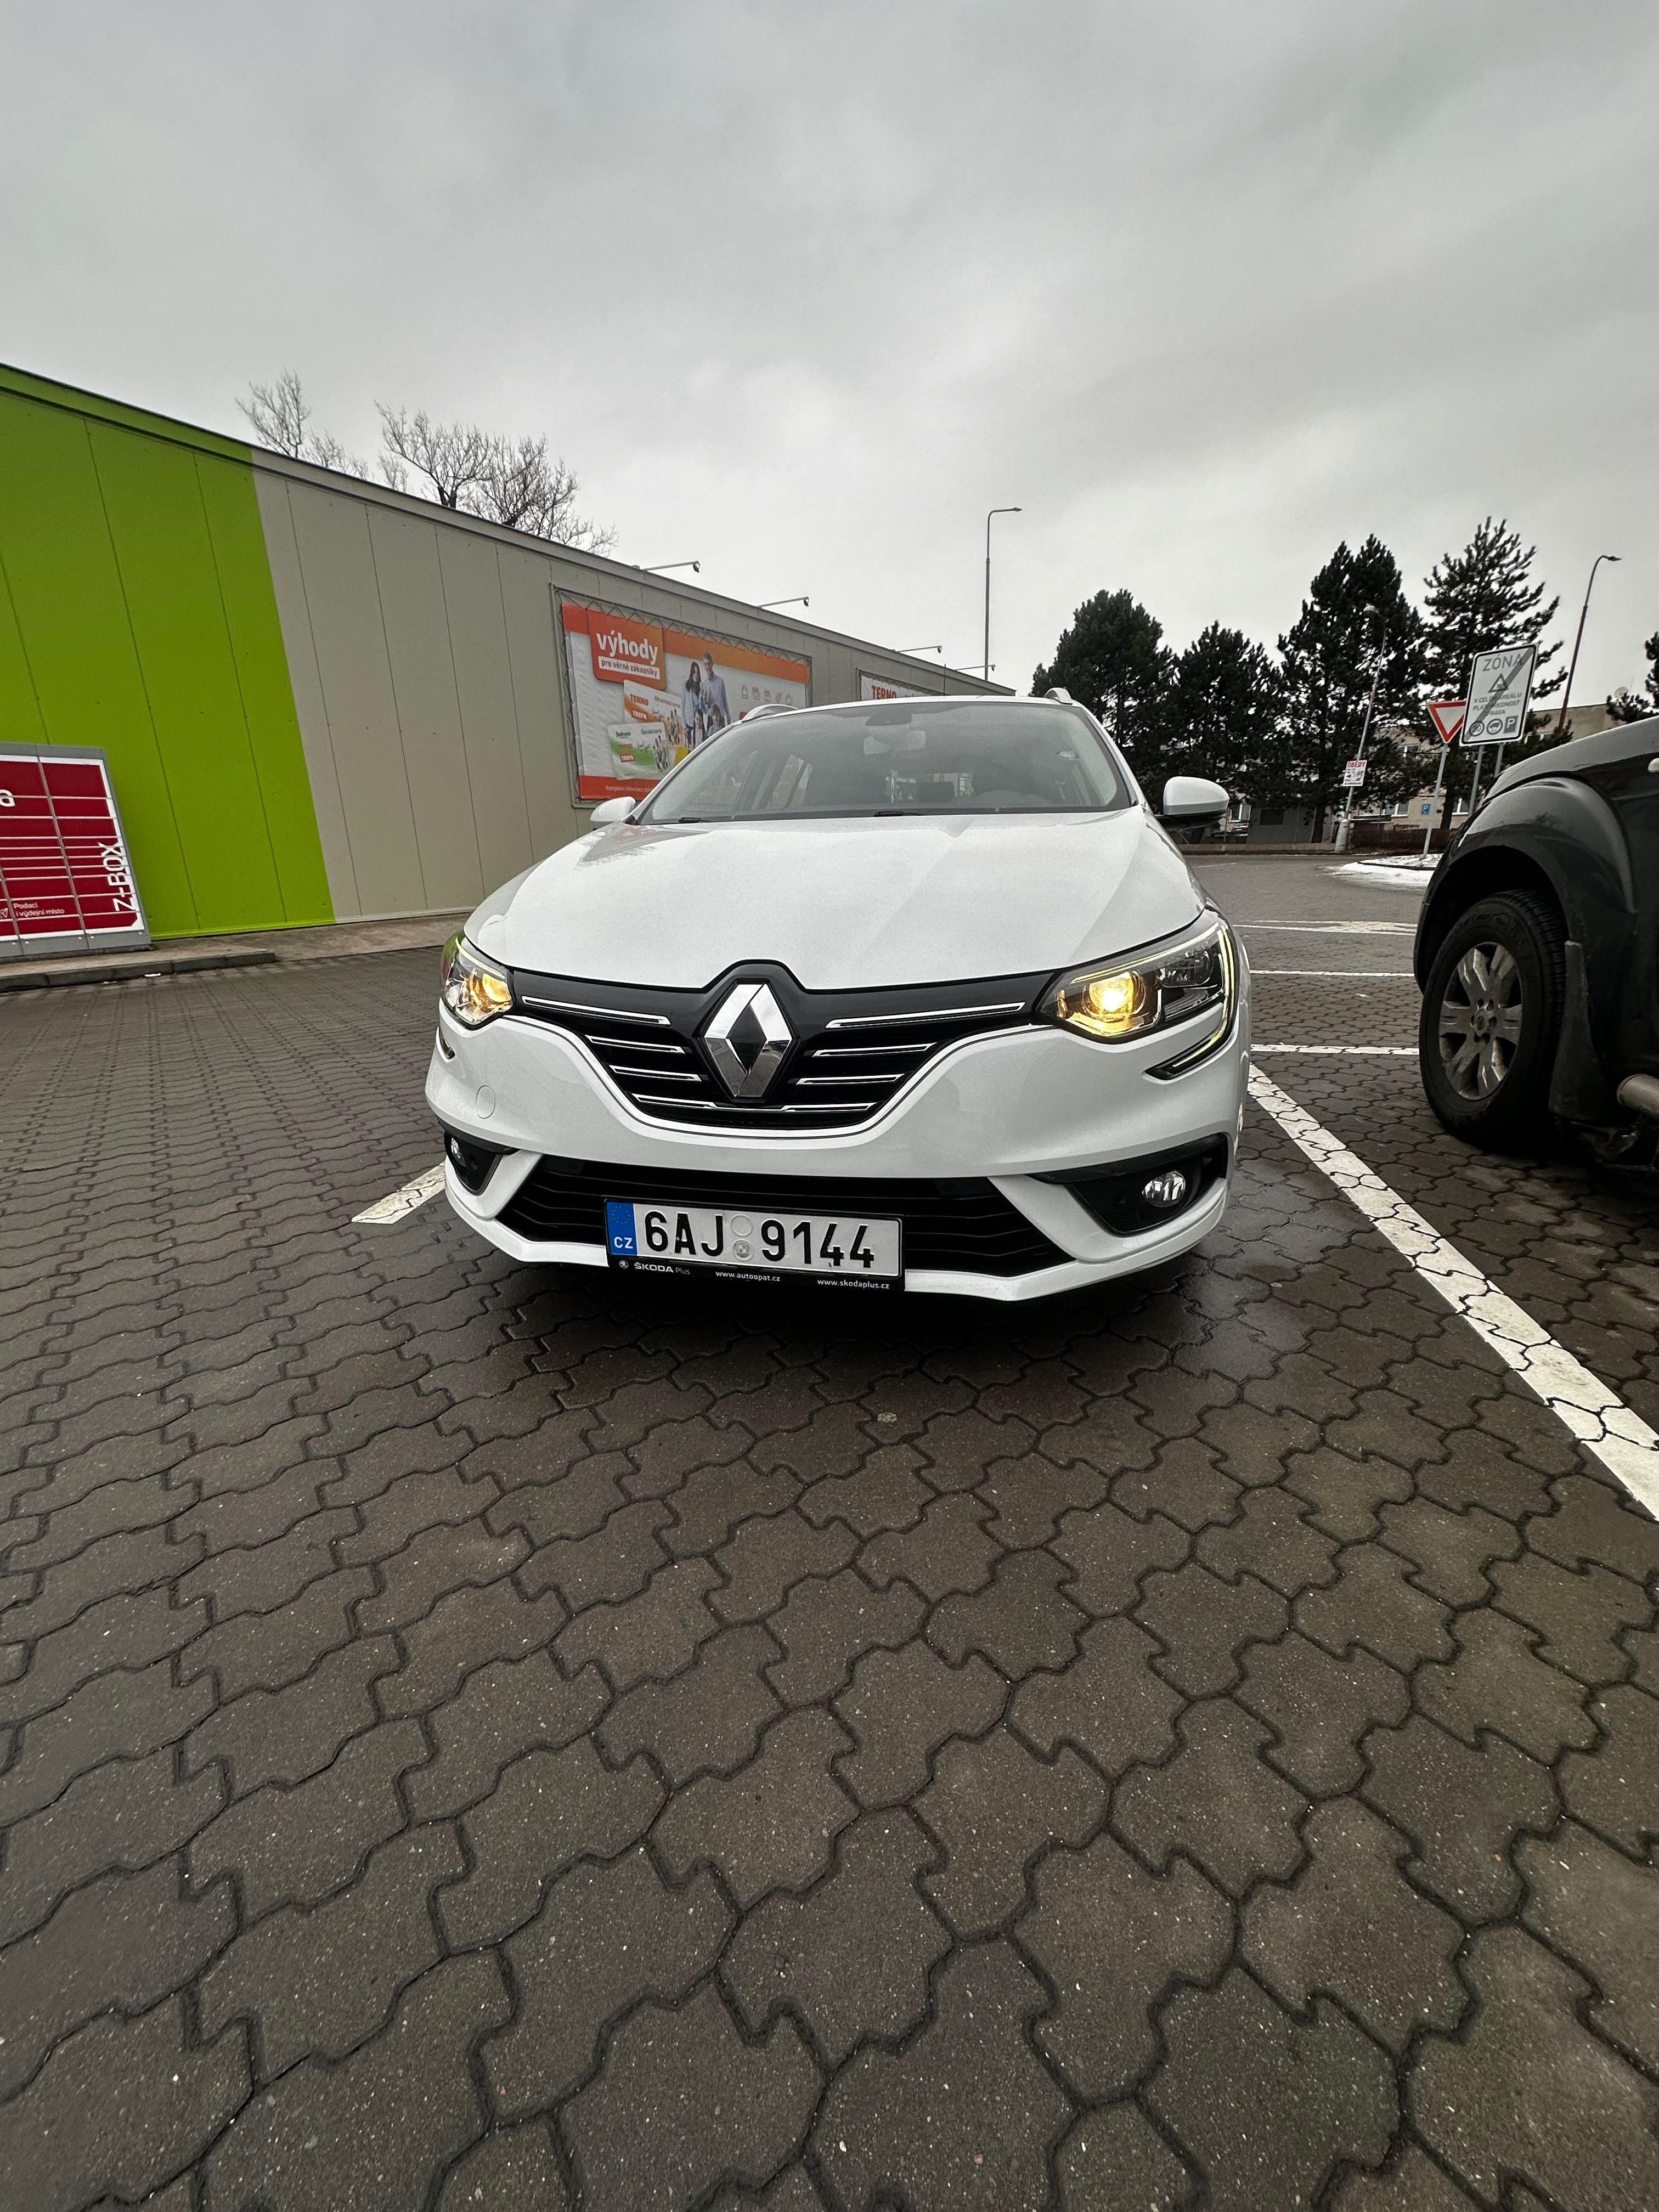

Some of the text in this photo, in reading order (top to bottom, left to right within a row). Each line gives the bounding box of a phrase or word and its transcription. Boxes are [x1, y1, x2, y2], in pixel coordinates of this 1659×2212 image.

[596, 630, 658, 665] výhody
[613, 661, 629, 670] věrné
[630, 665, 657, 677] zákazníky
[872, 685, 897, 699] TERNO
[630, 694, 648, 706] TERNO
[1506, 718, 1515, 729] P
[98, 842, 137, 912] Z-BOX
[613, 1236, 633, 1249] CZ
[644, 1210, 875, 1268] 6AJ 9144
[634, 1262, 674, 1273] ŠKODA
[715, 1271, 781, 1282] www.autoopat.cz
[817, 1279, 890, 1289] www.skodaplus.cz
